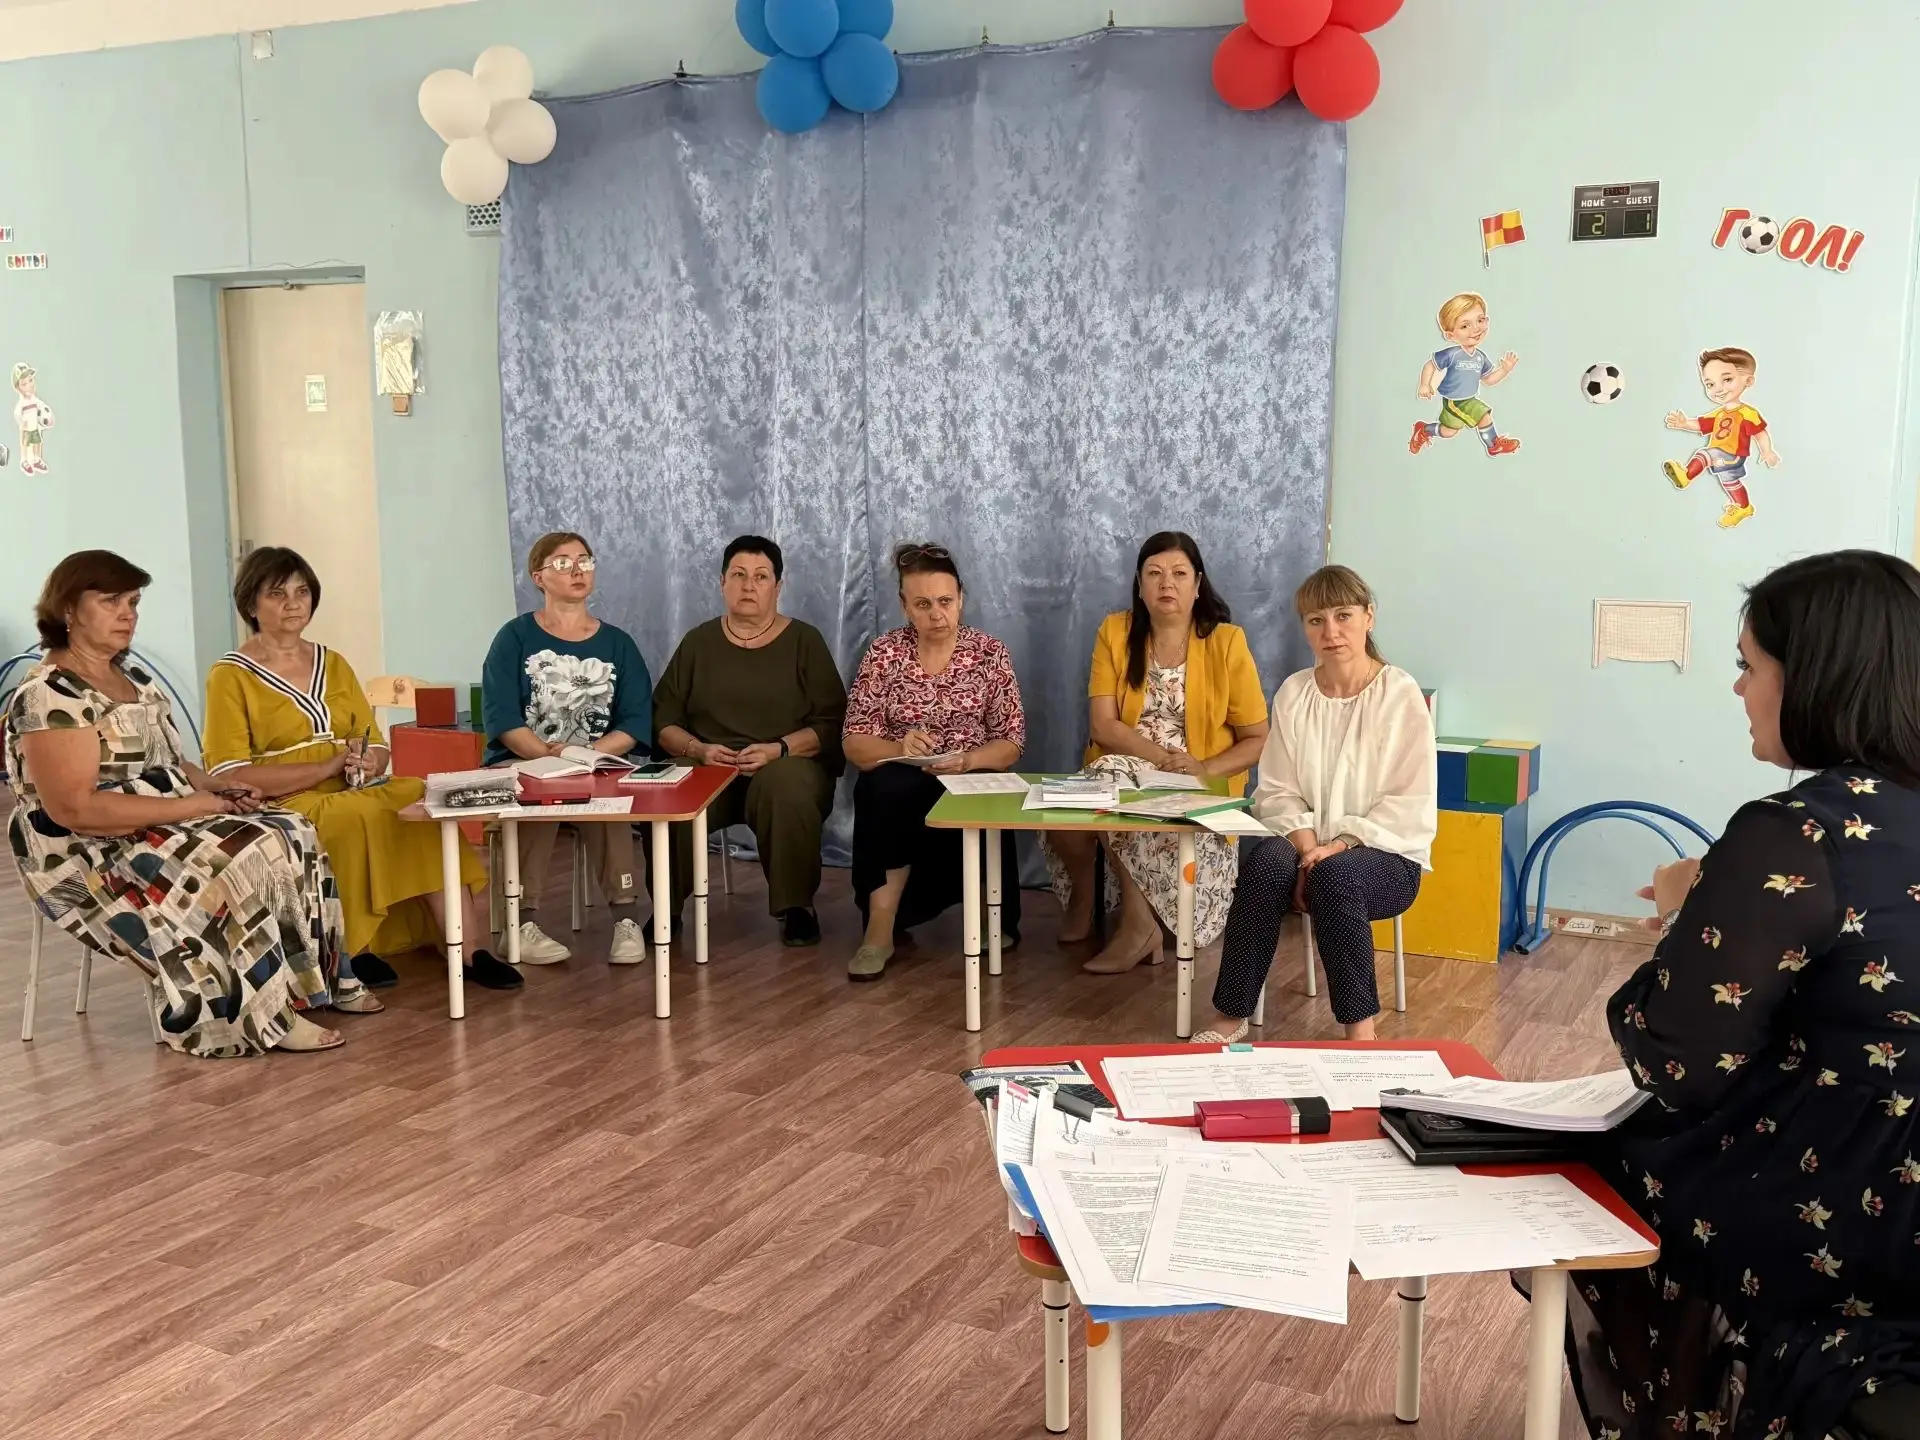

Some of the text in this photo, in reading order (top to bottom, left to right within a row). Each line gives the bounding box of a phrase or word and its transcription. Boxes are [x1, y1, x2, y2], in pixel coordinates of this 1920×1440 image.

[1581, 198, 1606, 208] HOME
[1626, 196, 1652, 205] GUEST
[1591, 212, 1651, 235] 2 1
[1715, 417, 1732, 440] 8
